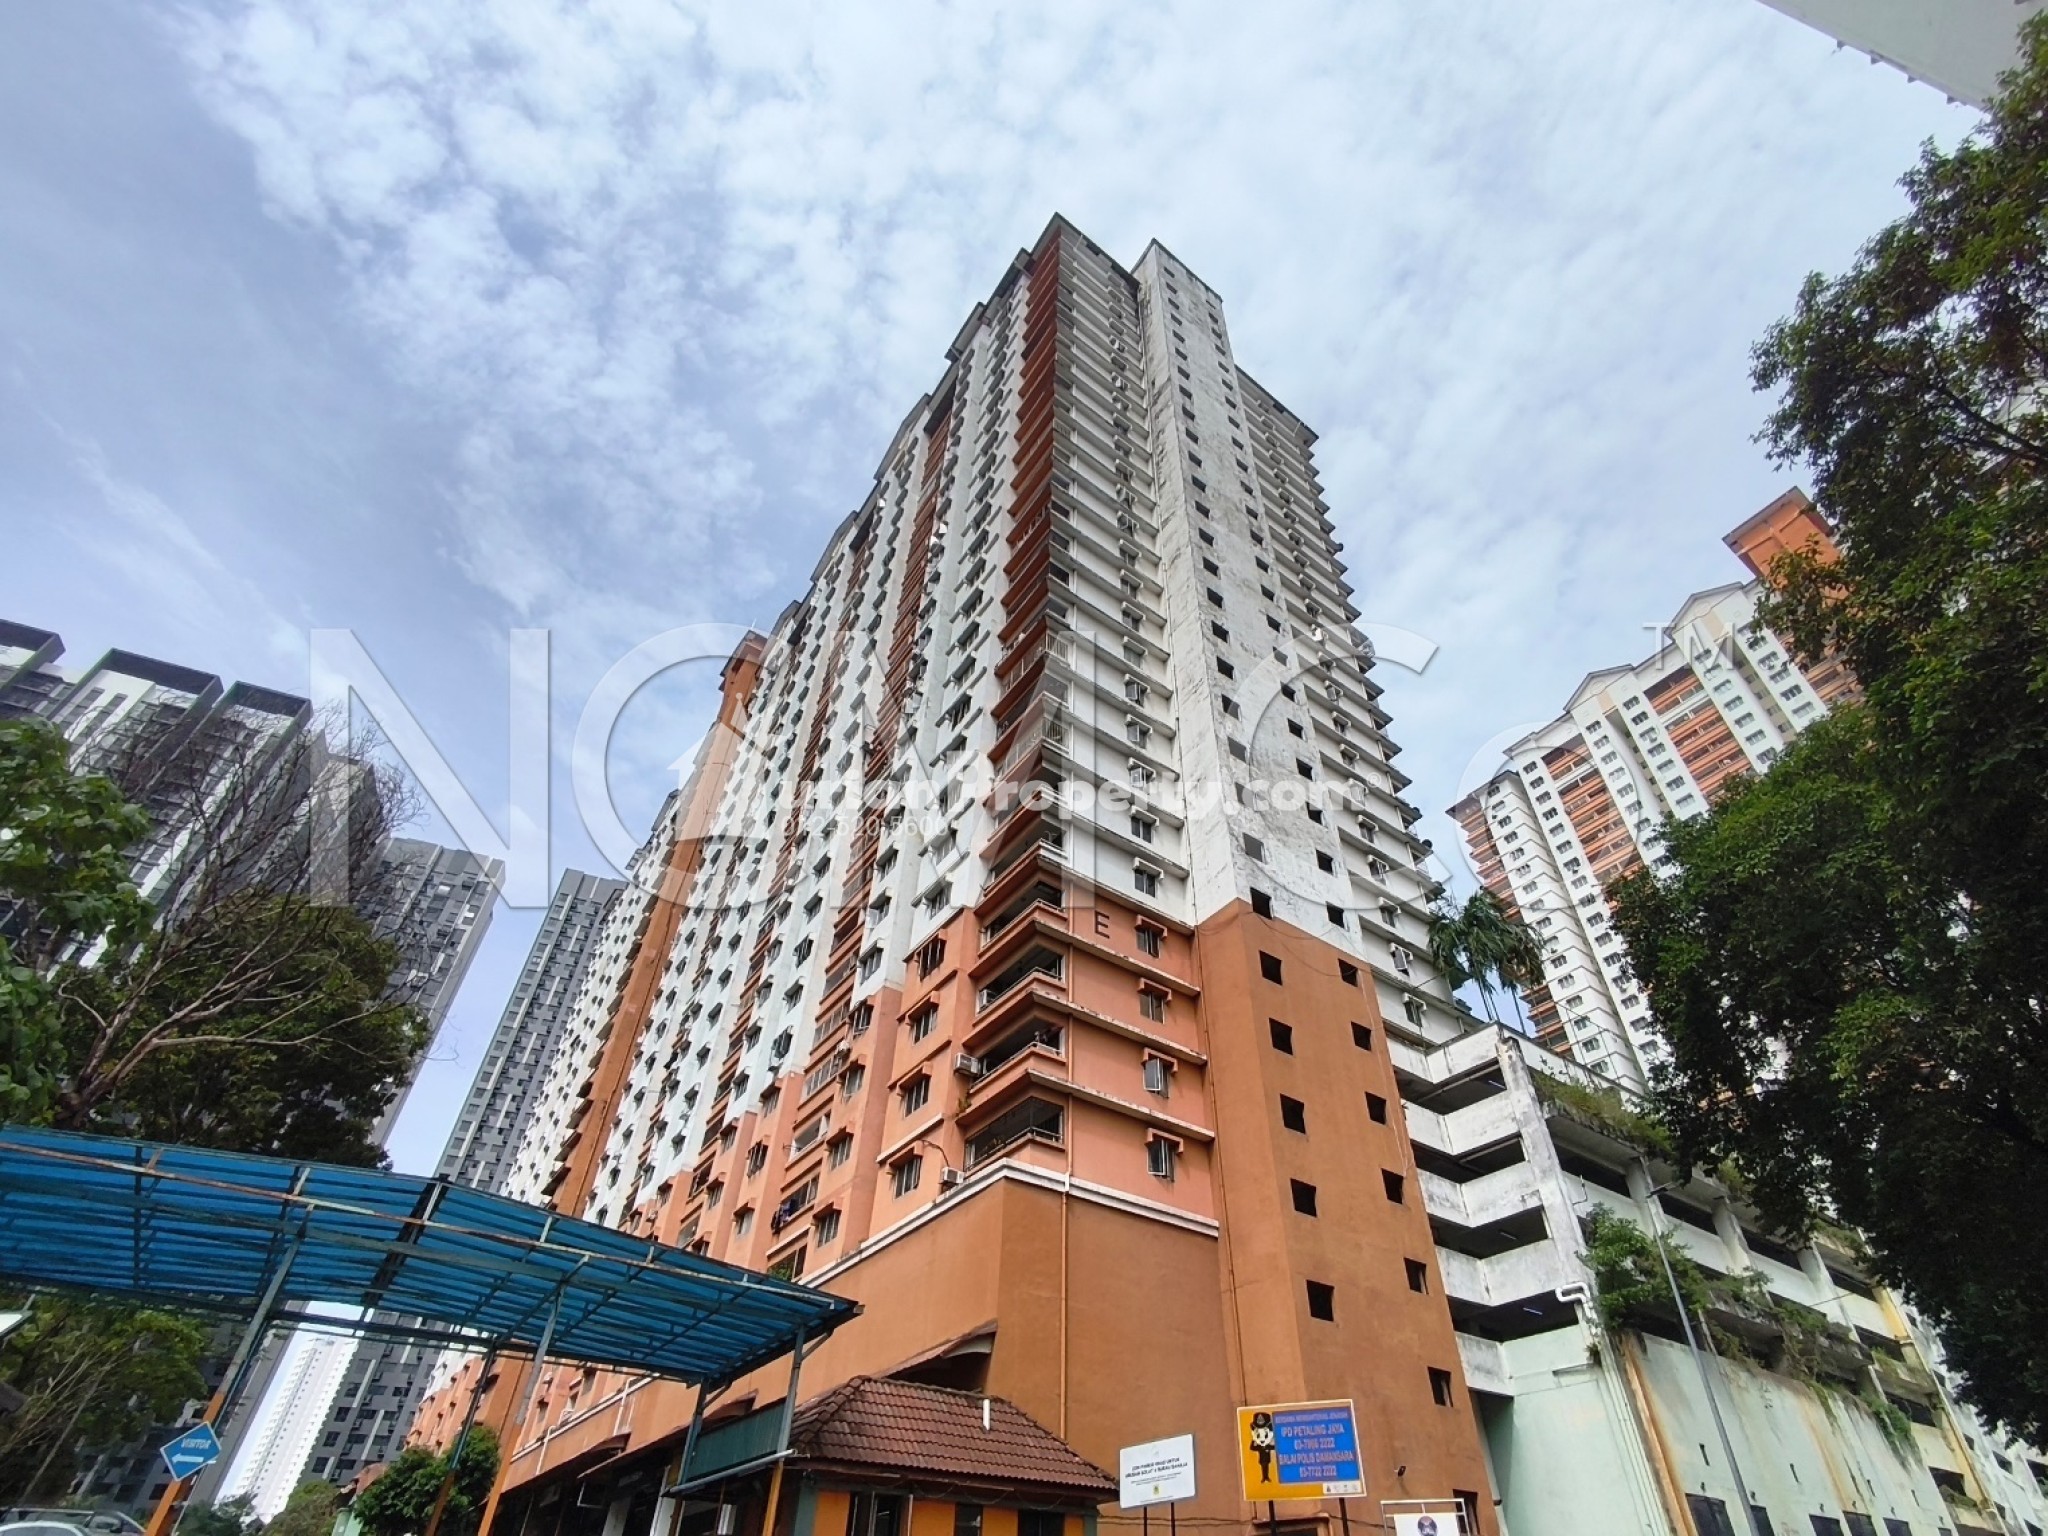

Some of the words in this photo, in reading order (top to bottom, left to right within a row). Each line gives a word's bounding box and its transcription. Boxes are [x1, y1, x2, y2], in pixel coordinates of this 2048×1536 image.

[1095, 910, 1110, 939] E
[1293, 1424, 1326, 1436] PETALING
[1328, 1423, 1345, 1434] JAYA
[1297, 1452, 1316, 1463] POLIS
[1315, 1450, 1354, 1462] DAMANSARA
